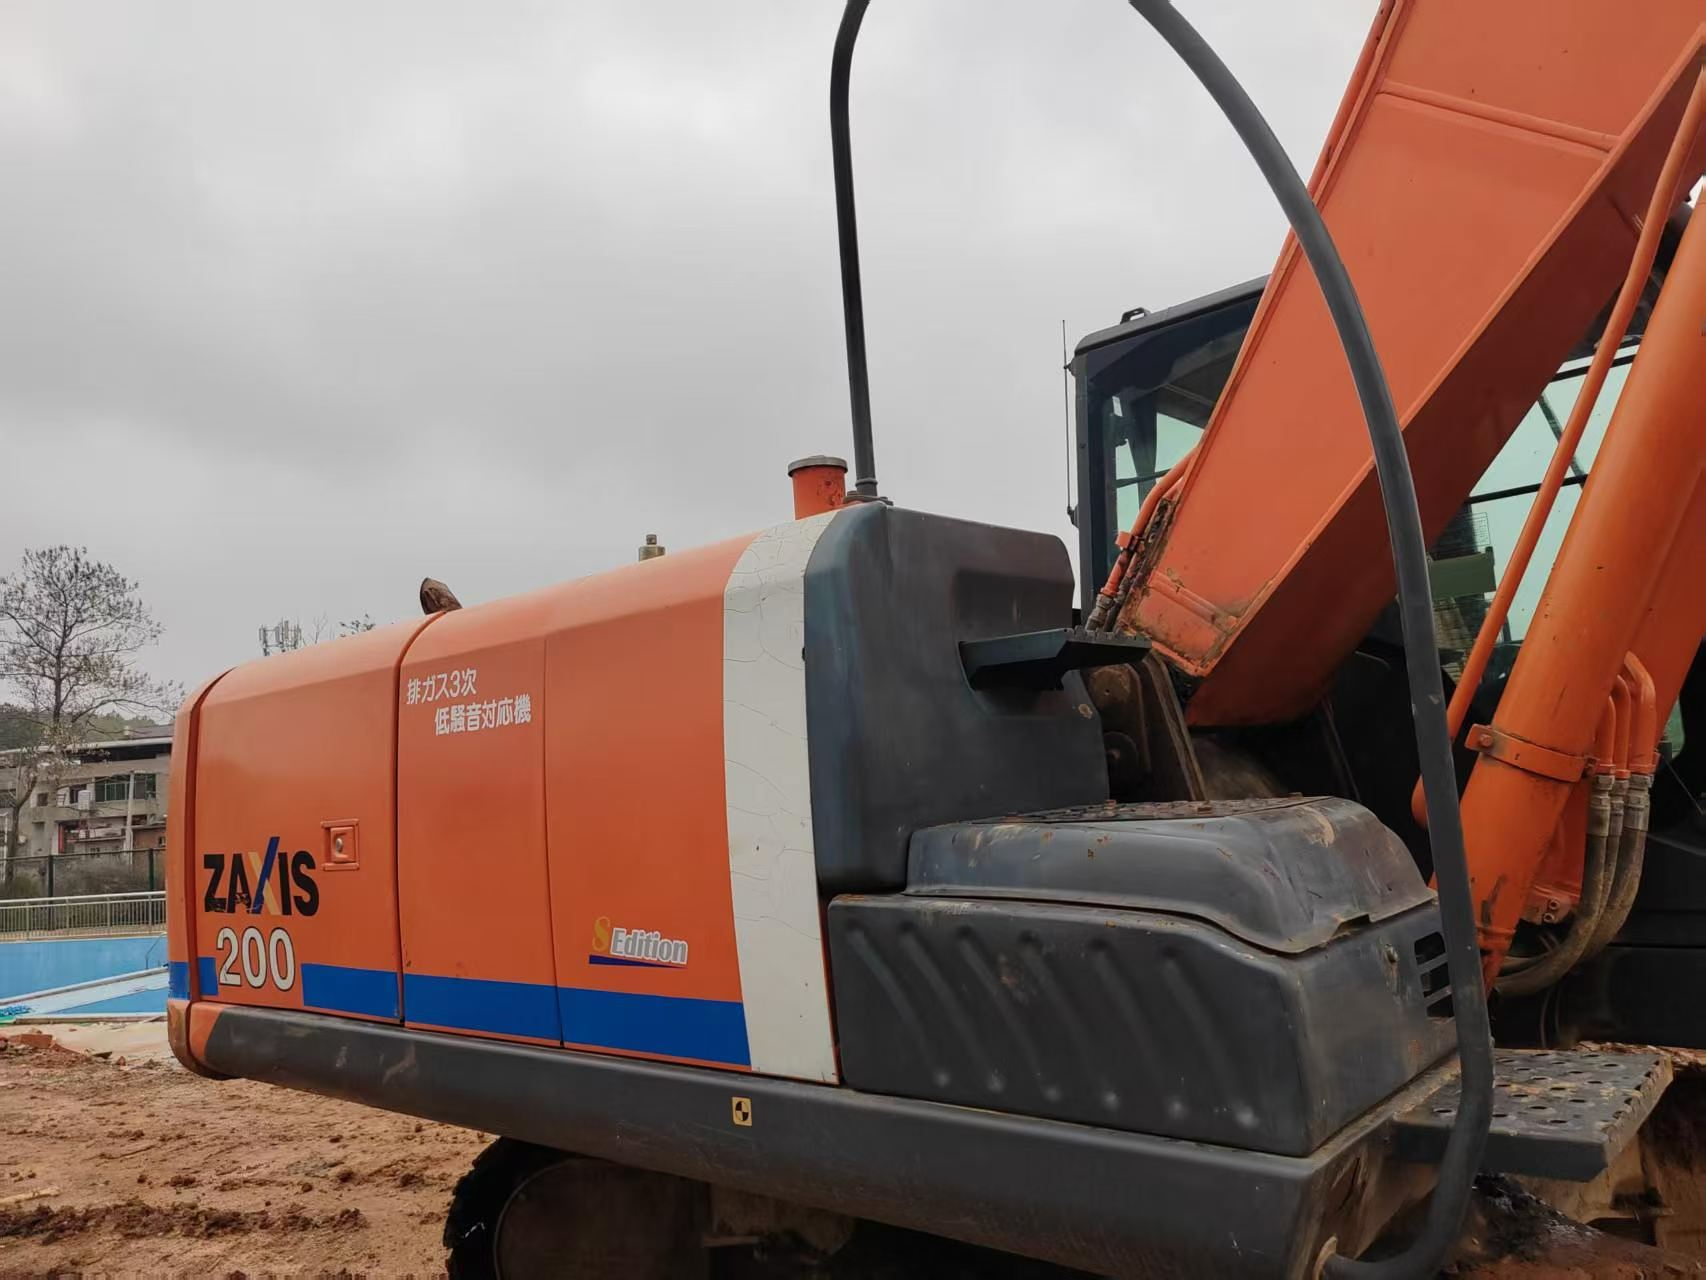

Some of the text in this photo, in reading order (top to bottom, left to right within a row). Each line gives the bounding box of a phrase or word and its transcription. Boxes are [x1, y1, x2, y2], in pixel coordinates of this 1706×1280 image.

[406, 668, 477, 704] 排ガス3次
[434, 693, 532, 736] 低騒音対応機
[204, 836, 319, 916] ZAXIS
[216, 926, 295, 992] 200
[610, 927, 689, 965] Edition
